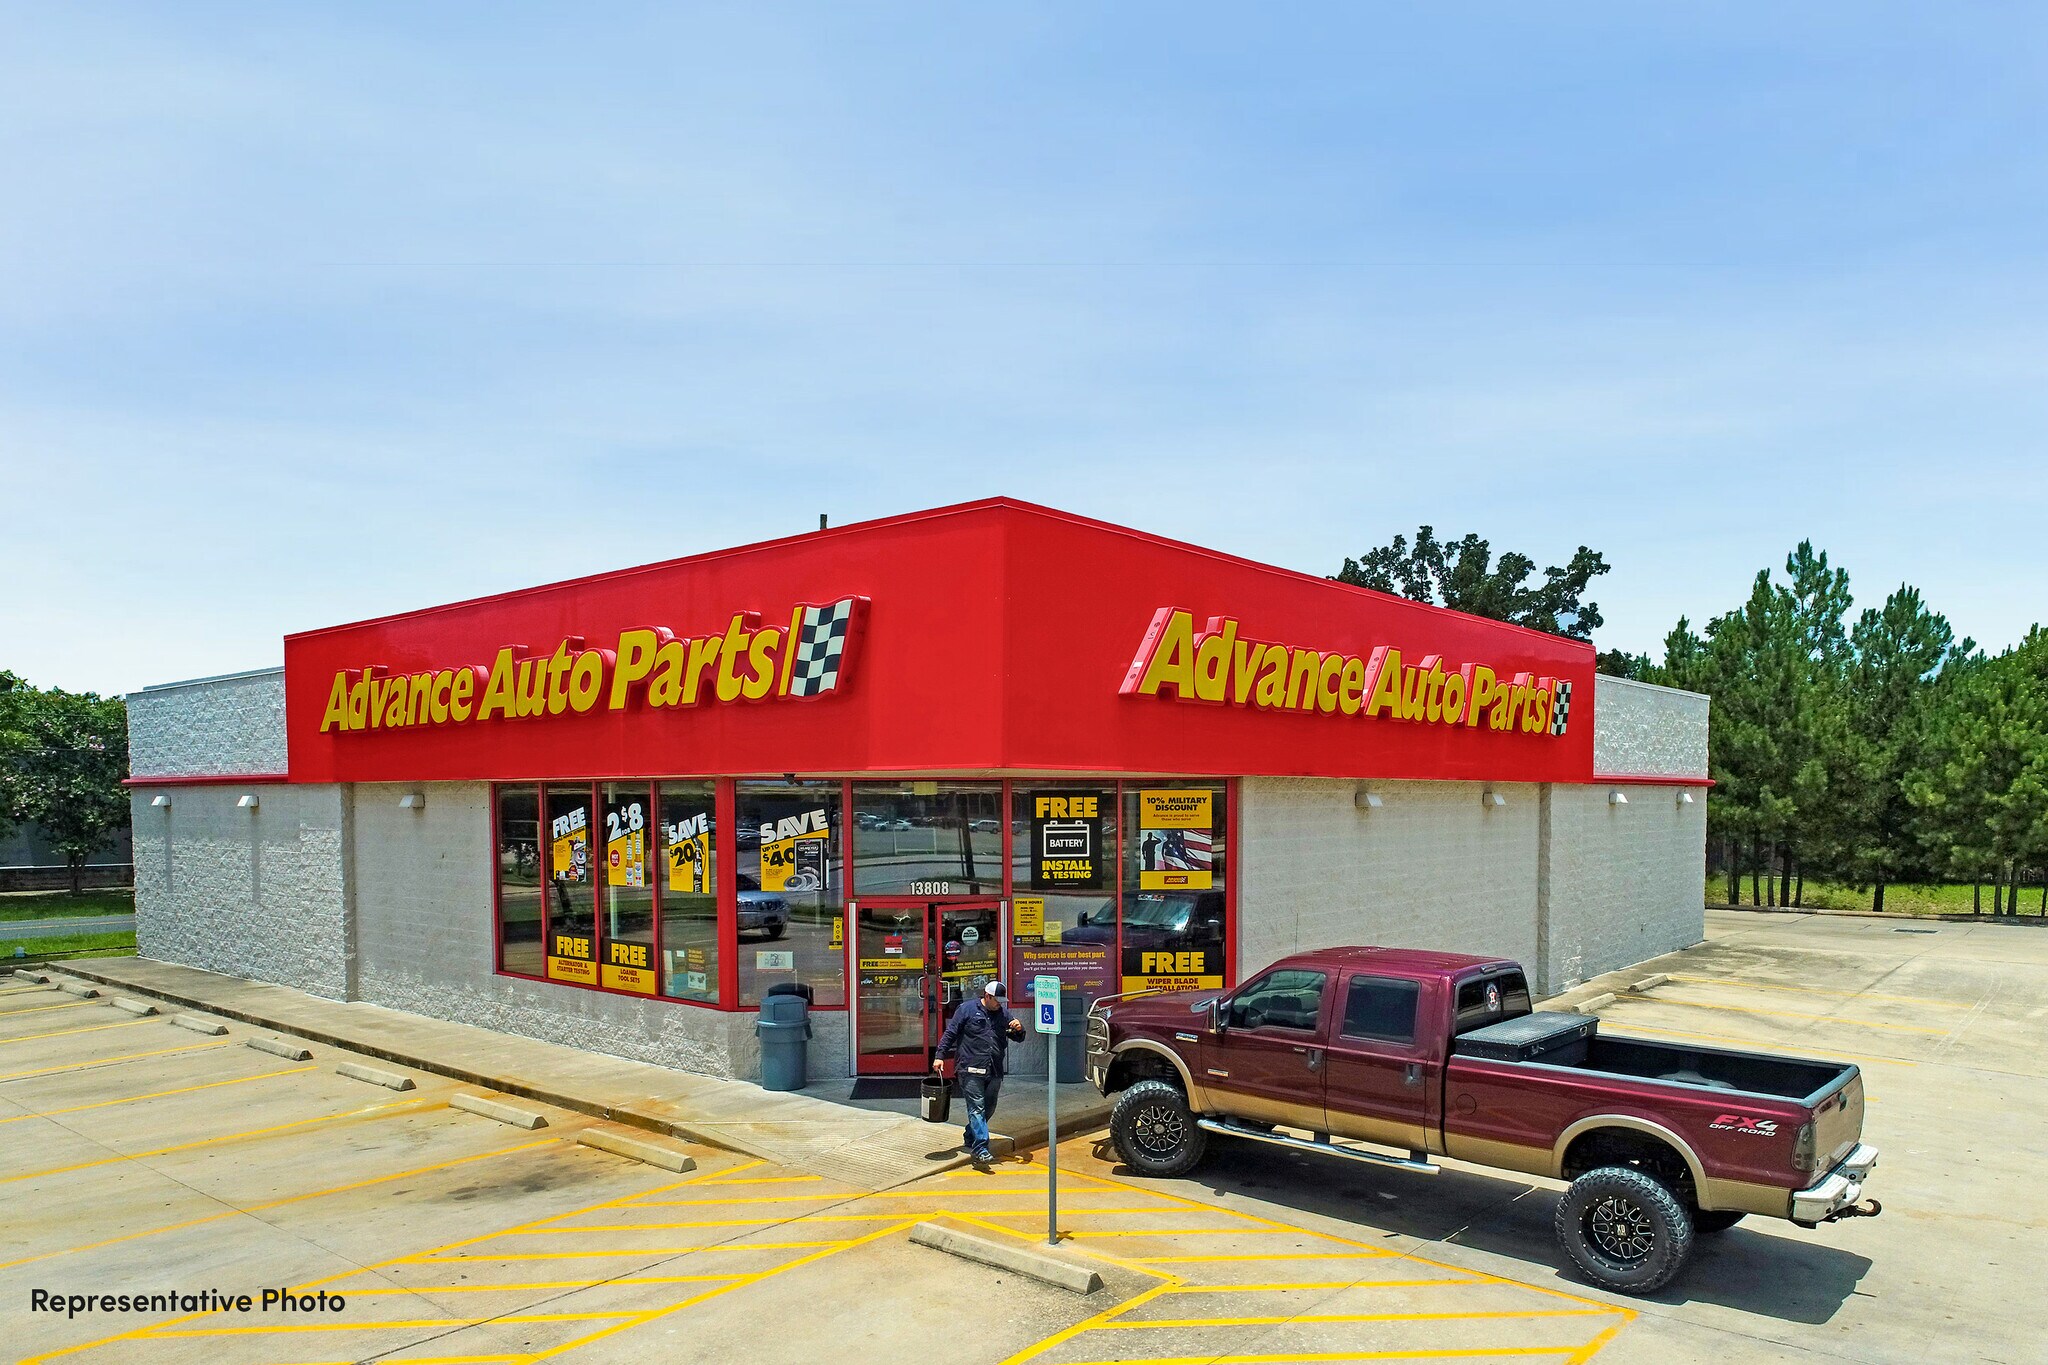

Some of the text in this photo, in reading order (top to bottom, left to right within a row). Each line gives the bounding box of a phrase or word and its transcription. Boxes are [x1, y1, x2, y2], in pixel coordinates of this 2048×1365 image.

[320, 614, 776, 733] Advance Auto Parts
[1137, 610, 1549, 734] Advance Auto Parts
[1035, 796, 1098, 818] FREE
[552, 806, 586, 839] FREE
[607, 812, 622, 843] 2
[621, 803, 644, 831] $8
[668, 812, 709, 845] SAVE
[760, 808, 829, 844] SAVE
[1049, 839, 1084, 848] BATTERY
[669, 842, 695, 867] $20
[1041, 860, 1092, 871] INSTALL
[1042, 871, 1092, 879] & TESTING
[910, 881, 949, 895] 13808
[556, 935, 590, 959] FREE
[610, 943, 647, 967] FREE
[1023, 952, 1037, 960] Why
[1092, 951, 1106, 959] part.
[556, 965, 573, 973] STARTER
[573, 967, 591, 976] TESTING
[558, 959, 583, 968] ALTERNATOR
[1141, 951, 1205, 973] FREE
[620, 968, 638, 976] LOANER
[1036, 981, 1059, 990] RESERVED
[1038, 990, 1057, 999] PARKING
[1713, 1114, 1779, 1132] FX4
[1738, 1127, 1776, 1137] ROAD
